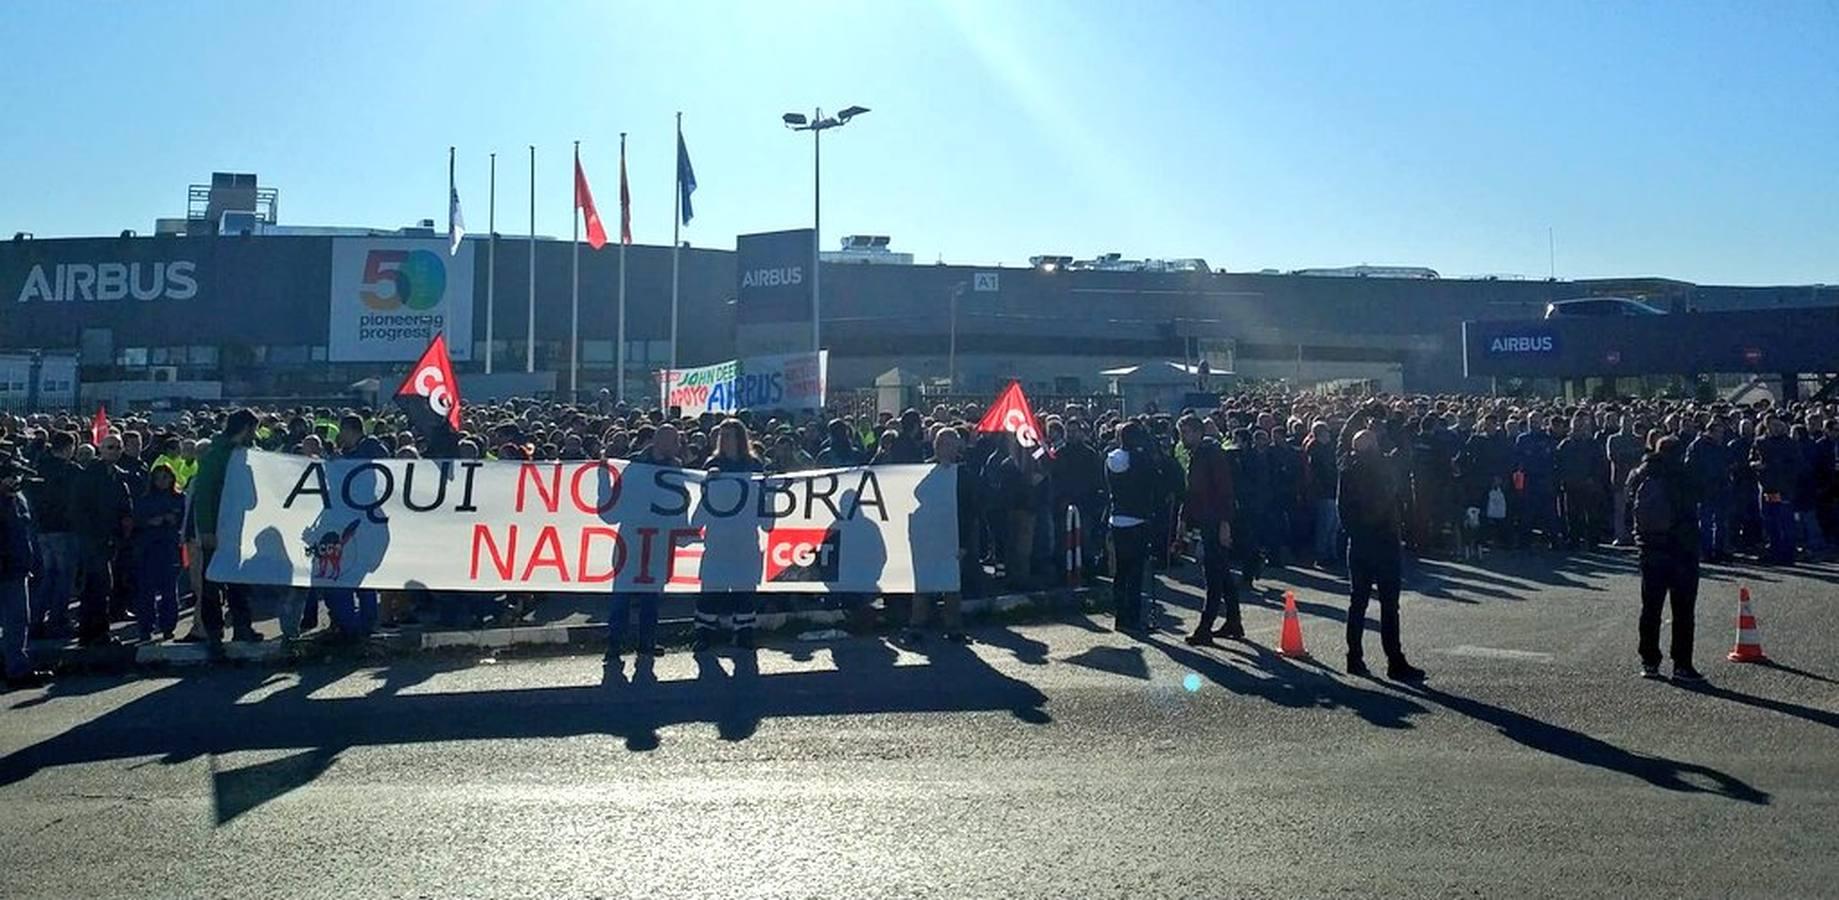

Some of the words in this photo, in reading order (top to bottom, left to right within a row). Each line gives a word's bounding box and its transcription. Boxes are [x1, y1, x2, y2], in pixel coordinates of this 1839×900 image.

[17, 261, 198, 302] AIRBUS
[360, 249, 447, 310] 50
[742, 266, 802, 288] AIRBUS
[977, 275, 996, 289] A1
[360, 327, 430, 341] progress
[1491, 336, 1553, 351] AIRBUS
[707, 370, 784, 411] AIRBUS
[282, 461, 484, 524] AQUI
[514, 461, 623, 515] NO
[650, 468, 889, 522] SOBRA
[469, 523, 707, 585] NADIE
[771, 542, 835, 567] CGT
